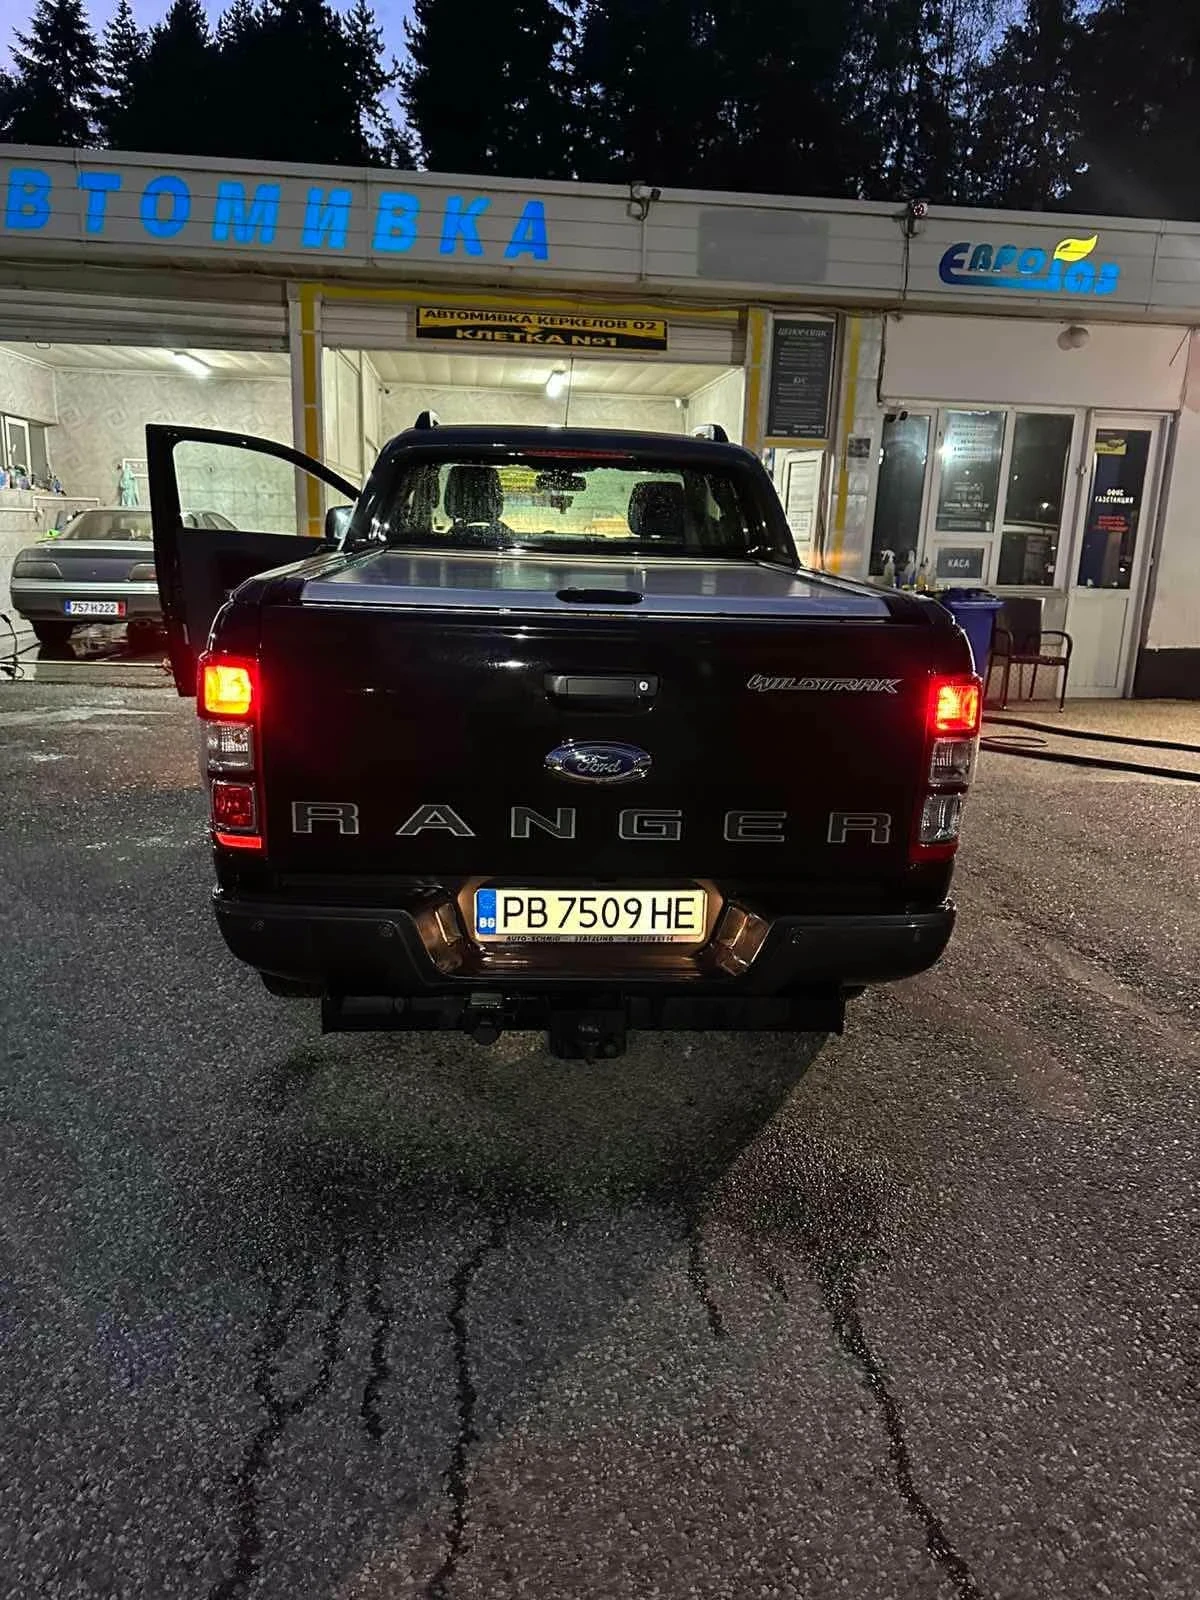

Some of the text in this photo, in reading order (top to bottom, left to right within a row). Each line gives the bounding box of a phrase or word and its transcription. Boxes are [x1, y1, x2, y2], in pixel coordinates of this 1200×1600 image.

[4, 167, 550, 262] ВТОМИВКА
[424, 309, 533, 325] АВТОМИВКА
[537, 316, 628, 330] КЕРКЕЛОВ
[455, 328, 567, 345] КЛЕТКА
[947, 558, 971, 570] КАСА
[72, 602, 89, 613] 757
[99, 603, 116, 613] 222
[746, 673, 904, 694] WILDTRAK
[576, 753, 622, 775] Ford
[290, 800, 892, 844] RANGER
[478, 916, 496, 929] BG
[503, 896, 695, 929] PB 7509 HE
